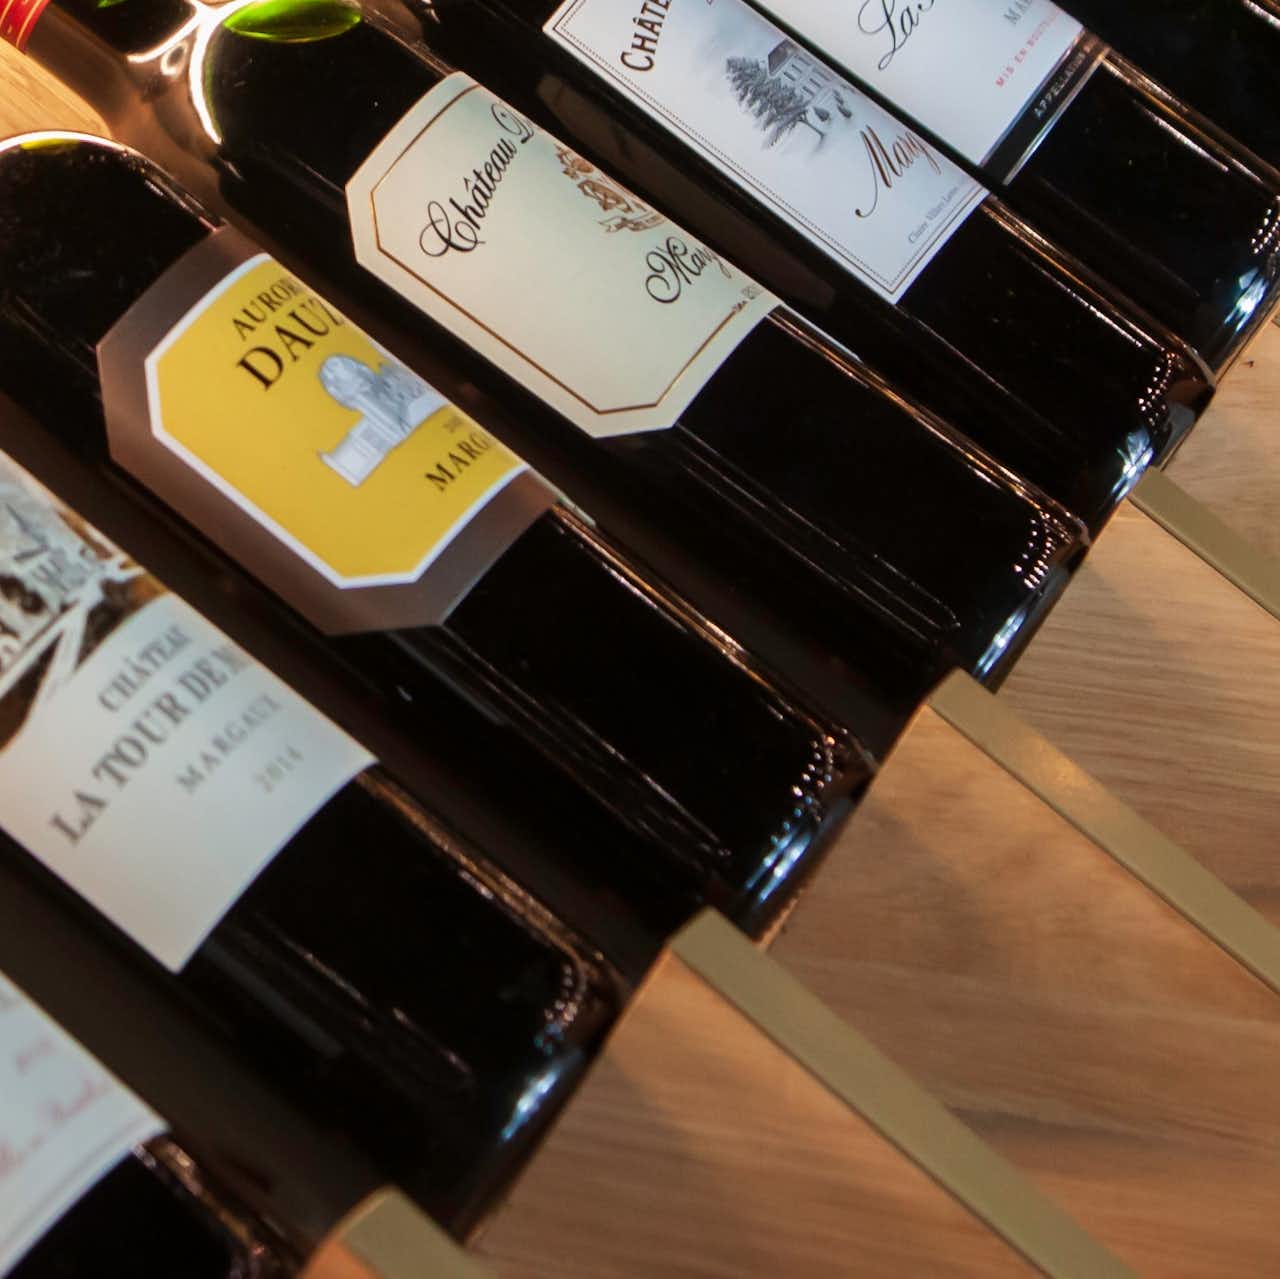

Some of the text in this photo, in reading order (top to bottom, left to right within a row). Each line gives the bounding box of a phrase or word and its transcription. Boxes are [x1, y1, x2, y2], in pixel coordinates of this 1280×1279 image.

[420, 135, 517, 257] Château
[50, 789, 107, 846] LA
[92, 690, 192, 788] TOUR
